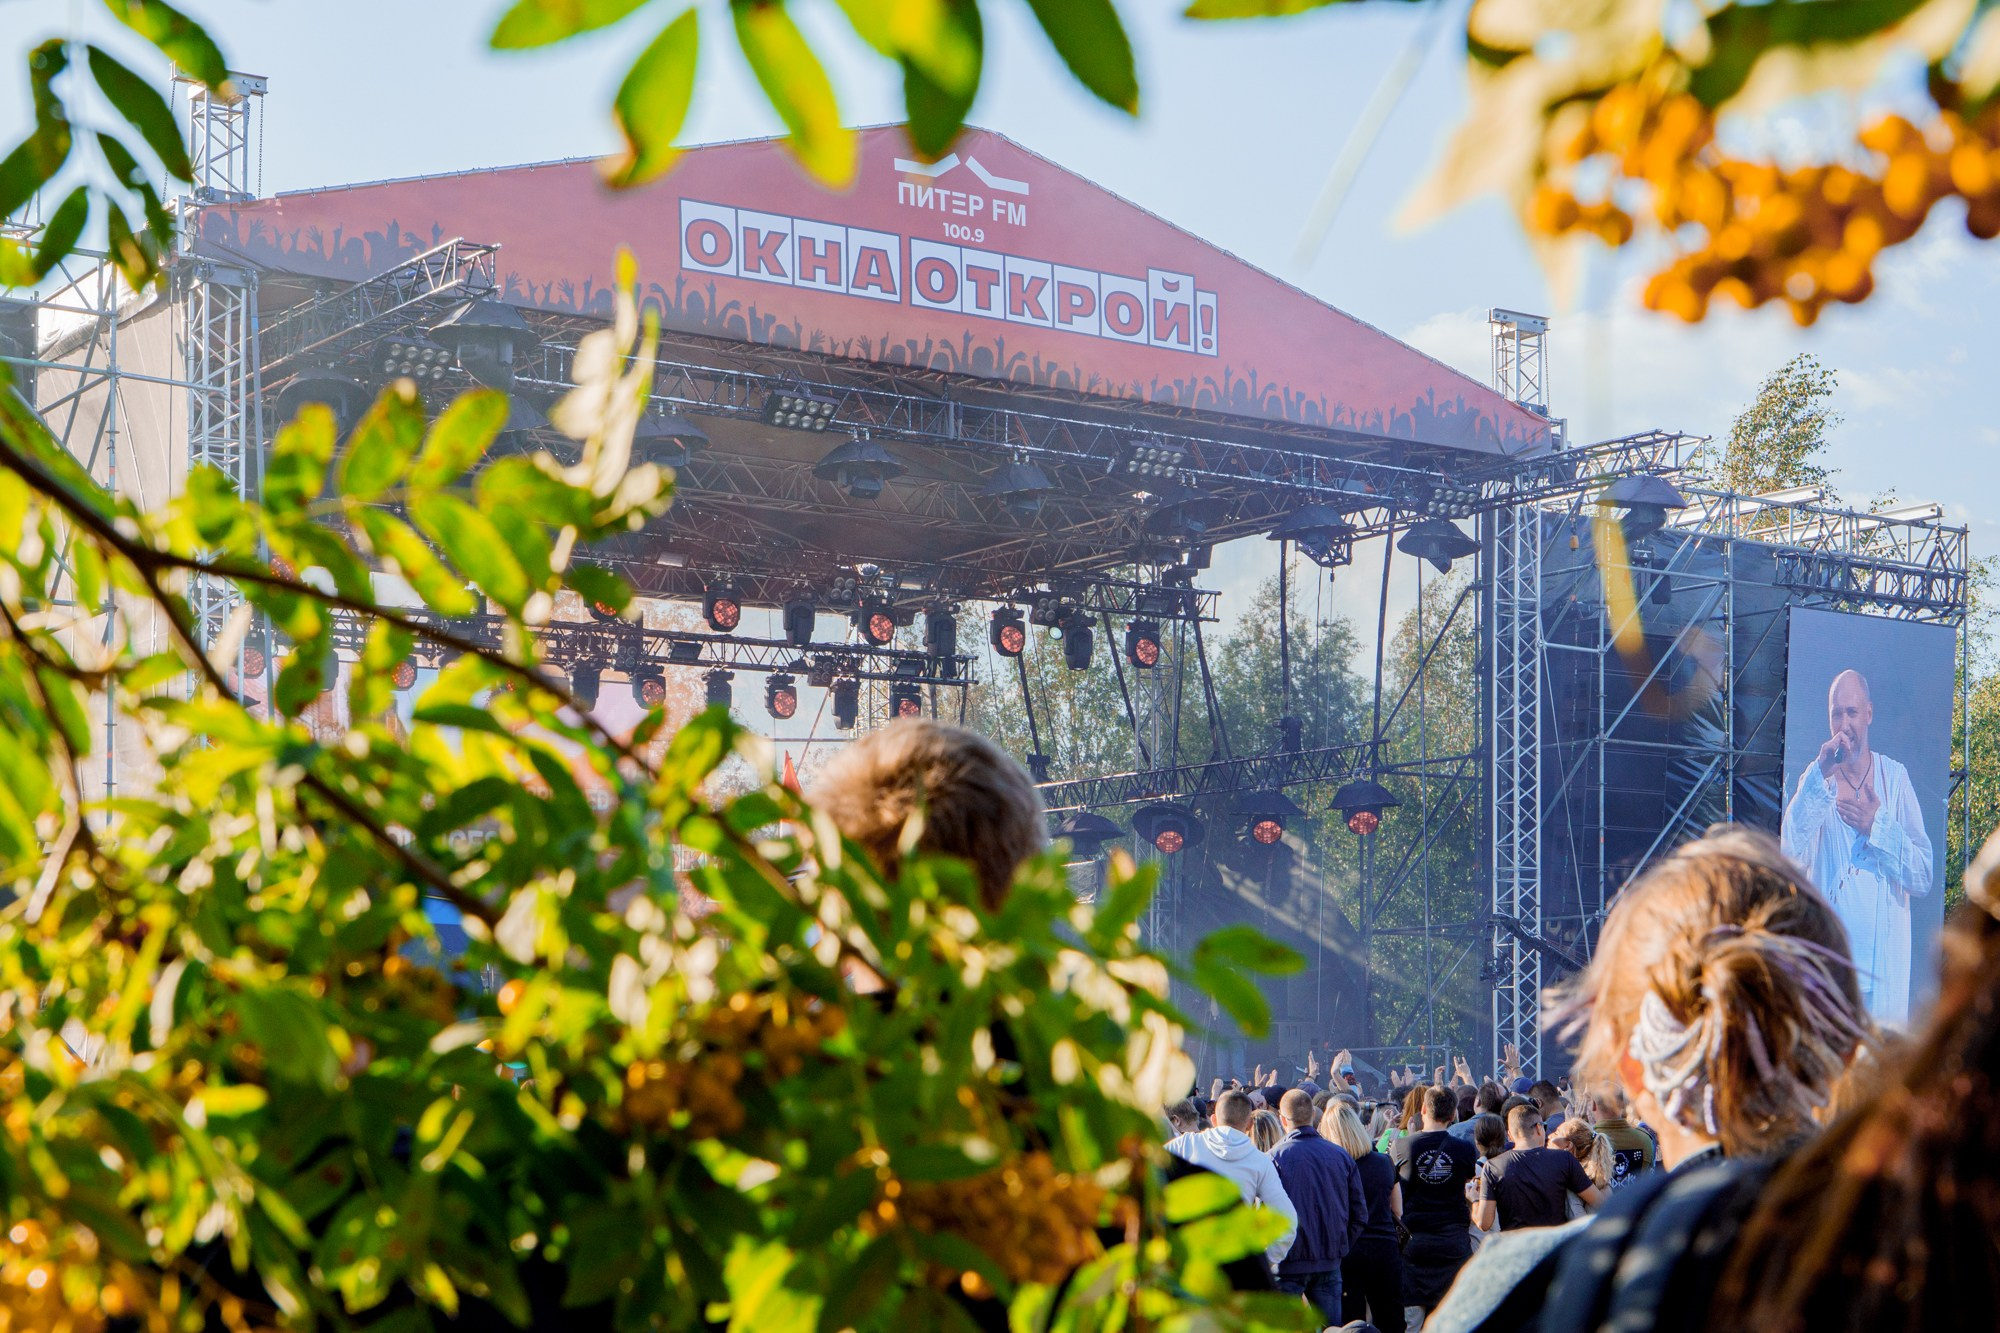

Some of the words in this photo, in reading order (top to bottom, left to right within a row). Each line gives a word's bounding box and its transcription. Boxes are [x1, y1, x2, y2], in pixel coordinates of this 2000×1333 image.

[898, 181, 984, 217] ПИТЕР
[992, 198, 1027, 227] FM
[942, 222, 985, 243] 100.9
[683, 217, 899, 296] ОКНА
[914, 255, 1215, 351] ОТКРОЙ!
